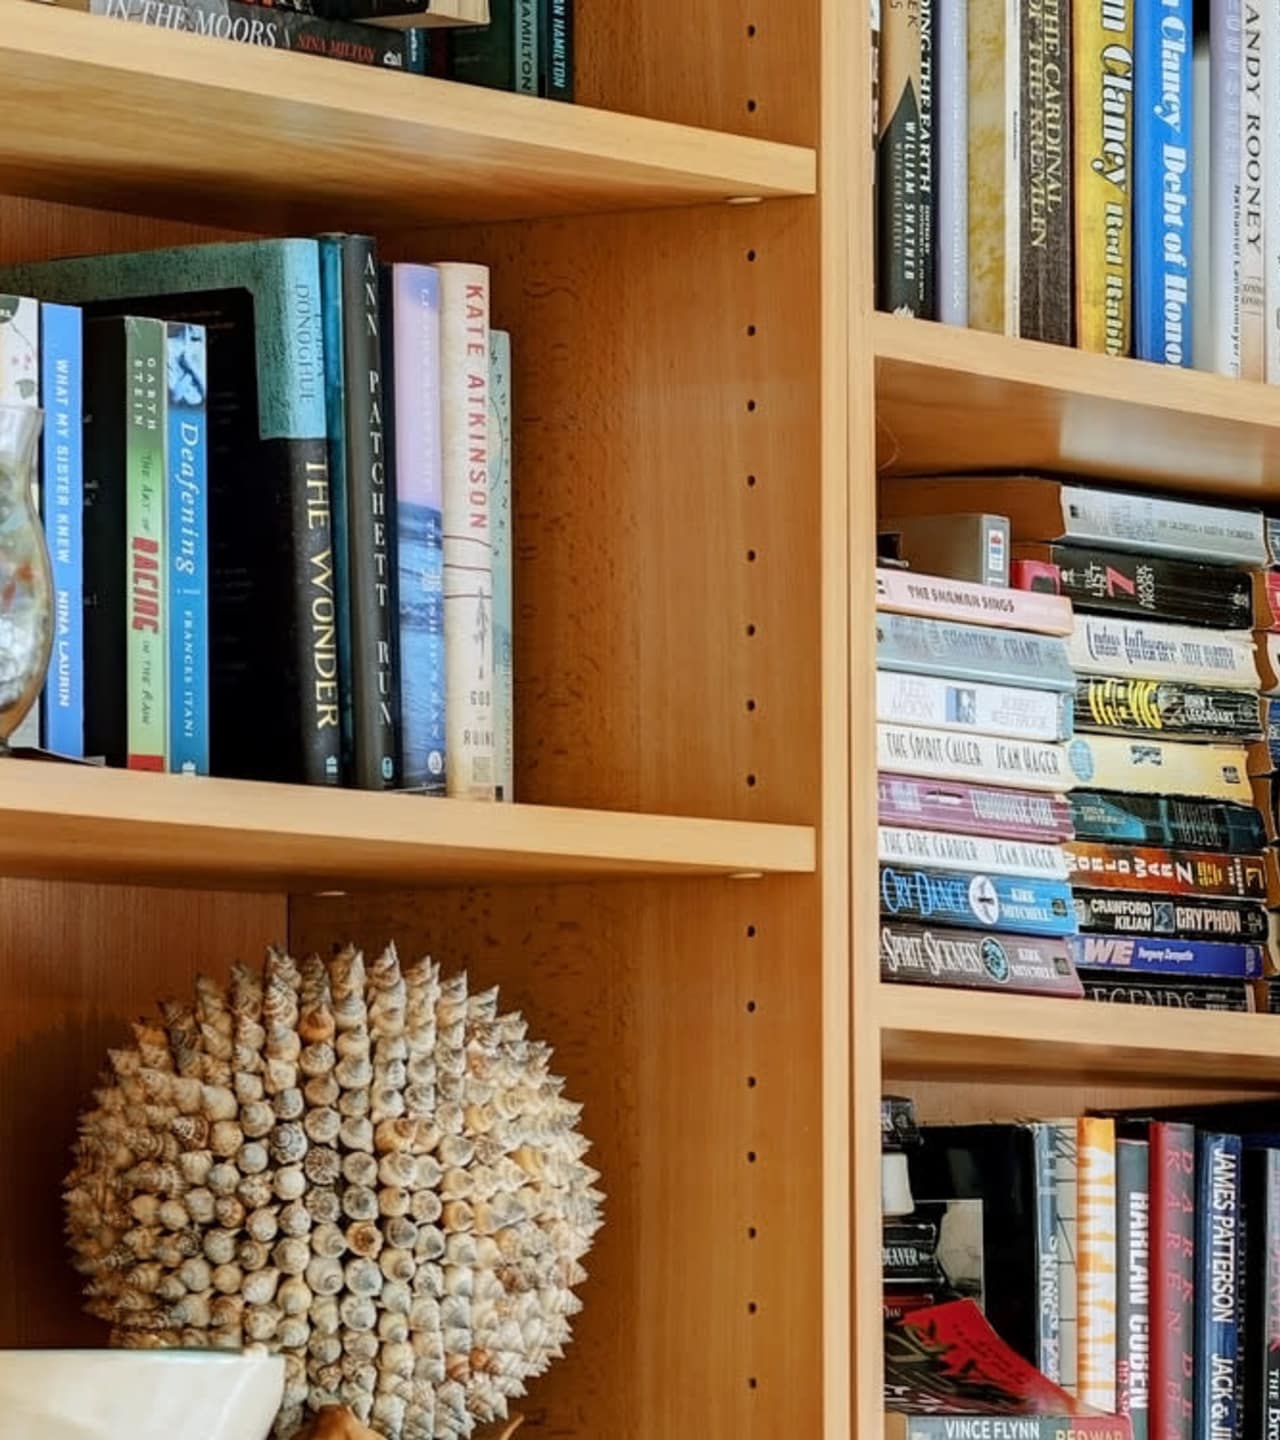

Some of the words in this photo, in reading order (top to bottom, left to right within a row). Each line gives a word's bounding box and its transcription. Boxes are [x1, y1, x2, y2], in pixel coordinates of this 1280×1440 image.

[184, 5, 279, 49] MOORS
[1245, 3, 1261, 100] ANDY
[1029, 35, 1043, 101] THE
[1153, 15, 1187, 134] Clancy
[919, 114, 932, 194] EARTH
[1044, 61, 1063, 213] CARDINAL
[1091, 43, 1133, 193] Clancy
[904, 120, 916, 195] WILLIAM
[1030, 107, 1047, 250] KREMLIN
[1163, 142, 1187, 228] Debt
[1246, 112, 1262, 254] ROONEY
[903, 201, 916, 282] SHATNER
[1104, 201, 1125, 265] Red
[1163, 231, 1187, 266] of
[364, 252, 378, 336] ANN
[464, 283, 489, 359] KATE
[55, 358, 71, 407] WHAT
[133, 358, 146, 427] STEIN
[146, 357, 158, 431] GARTH
[55, 412, 71, 439] MY
[465, 373, 490, 531] ATKINSON
[55, 444, 71, 507] SISTER
[174, 420, 201, 577] Deafening
[304, 457, 330, 530] THE
[368, 371, 387, 607] PATCHETT
[55, 513, 72, 564] KNEW
[56, 590, 71, 637] NINA
[132, 535, 161, 635] RACING
[907, 583, 932, 602] THE
[981, 596, 1015, 614] SINGS
[57, 640, 71, 709] LAURIN
[183, 609, 195, 685] FRANCES
[308, 549, 339, 730] WONDER
[183, 688, 195, 739] ITANI
[376, 641, 392, 728] RUN
[885, 732, 908, 759] THE
[908, 733, 946, 763] SPIRIT
[944, 736, 984, 767] CALLER
[995, 743, 1024, 769] JEAN
[1022, 745, 1061, 775] HAGER
[1089, 898, 1152, 917] CRAWFORD
[1133, 857, 1175, 878] WAR
[1175, 861, 1195, 885] Z
[1083, 937, 1136, 967] WE
[1113, 915, 1152, 932] KILIAN
[1175, 906, 1242, 934] GRYPHON
[1212, 1148, 1236, 1212] JAMES
[1128, 1191, 1150, 1305] HARLAN
[1167, 1149, 1181, 1336] KAREN
[1181, 1149, 1194, 1305] DARK
[1211, 1214, 1236, 1324] PATTERSON
[1211, 1352, 1234, 1400] JACK
[1211, 1402, 1231, 1420] &
[944, 1420, 991, 1440] VINCE
[993, 1420, 1041, 1440] FLYNN
